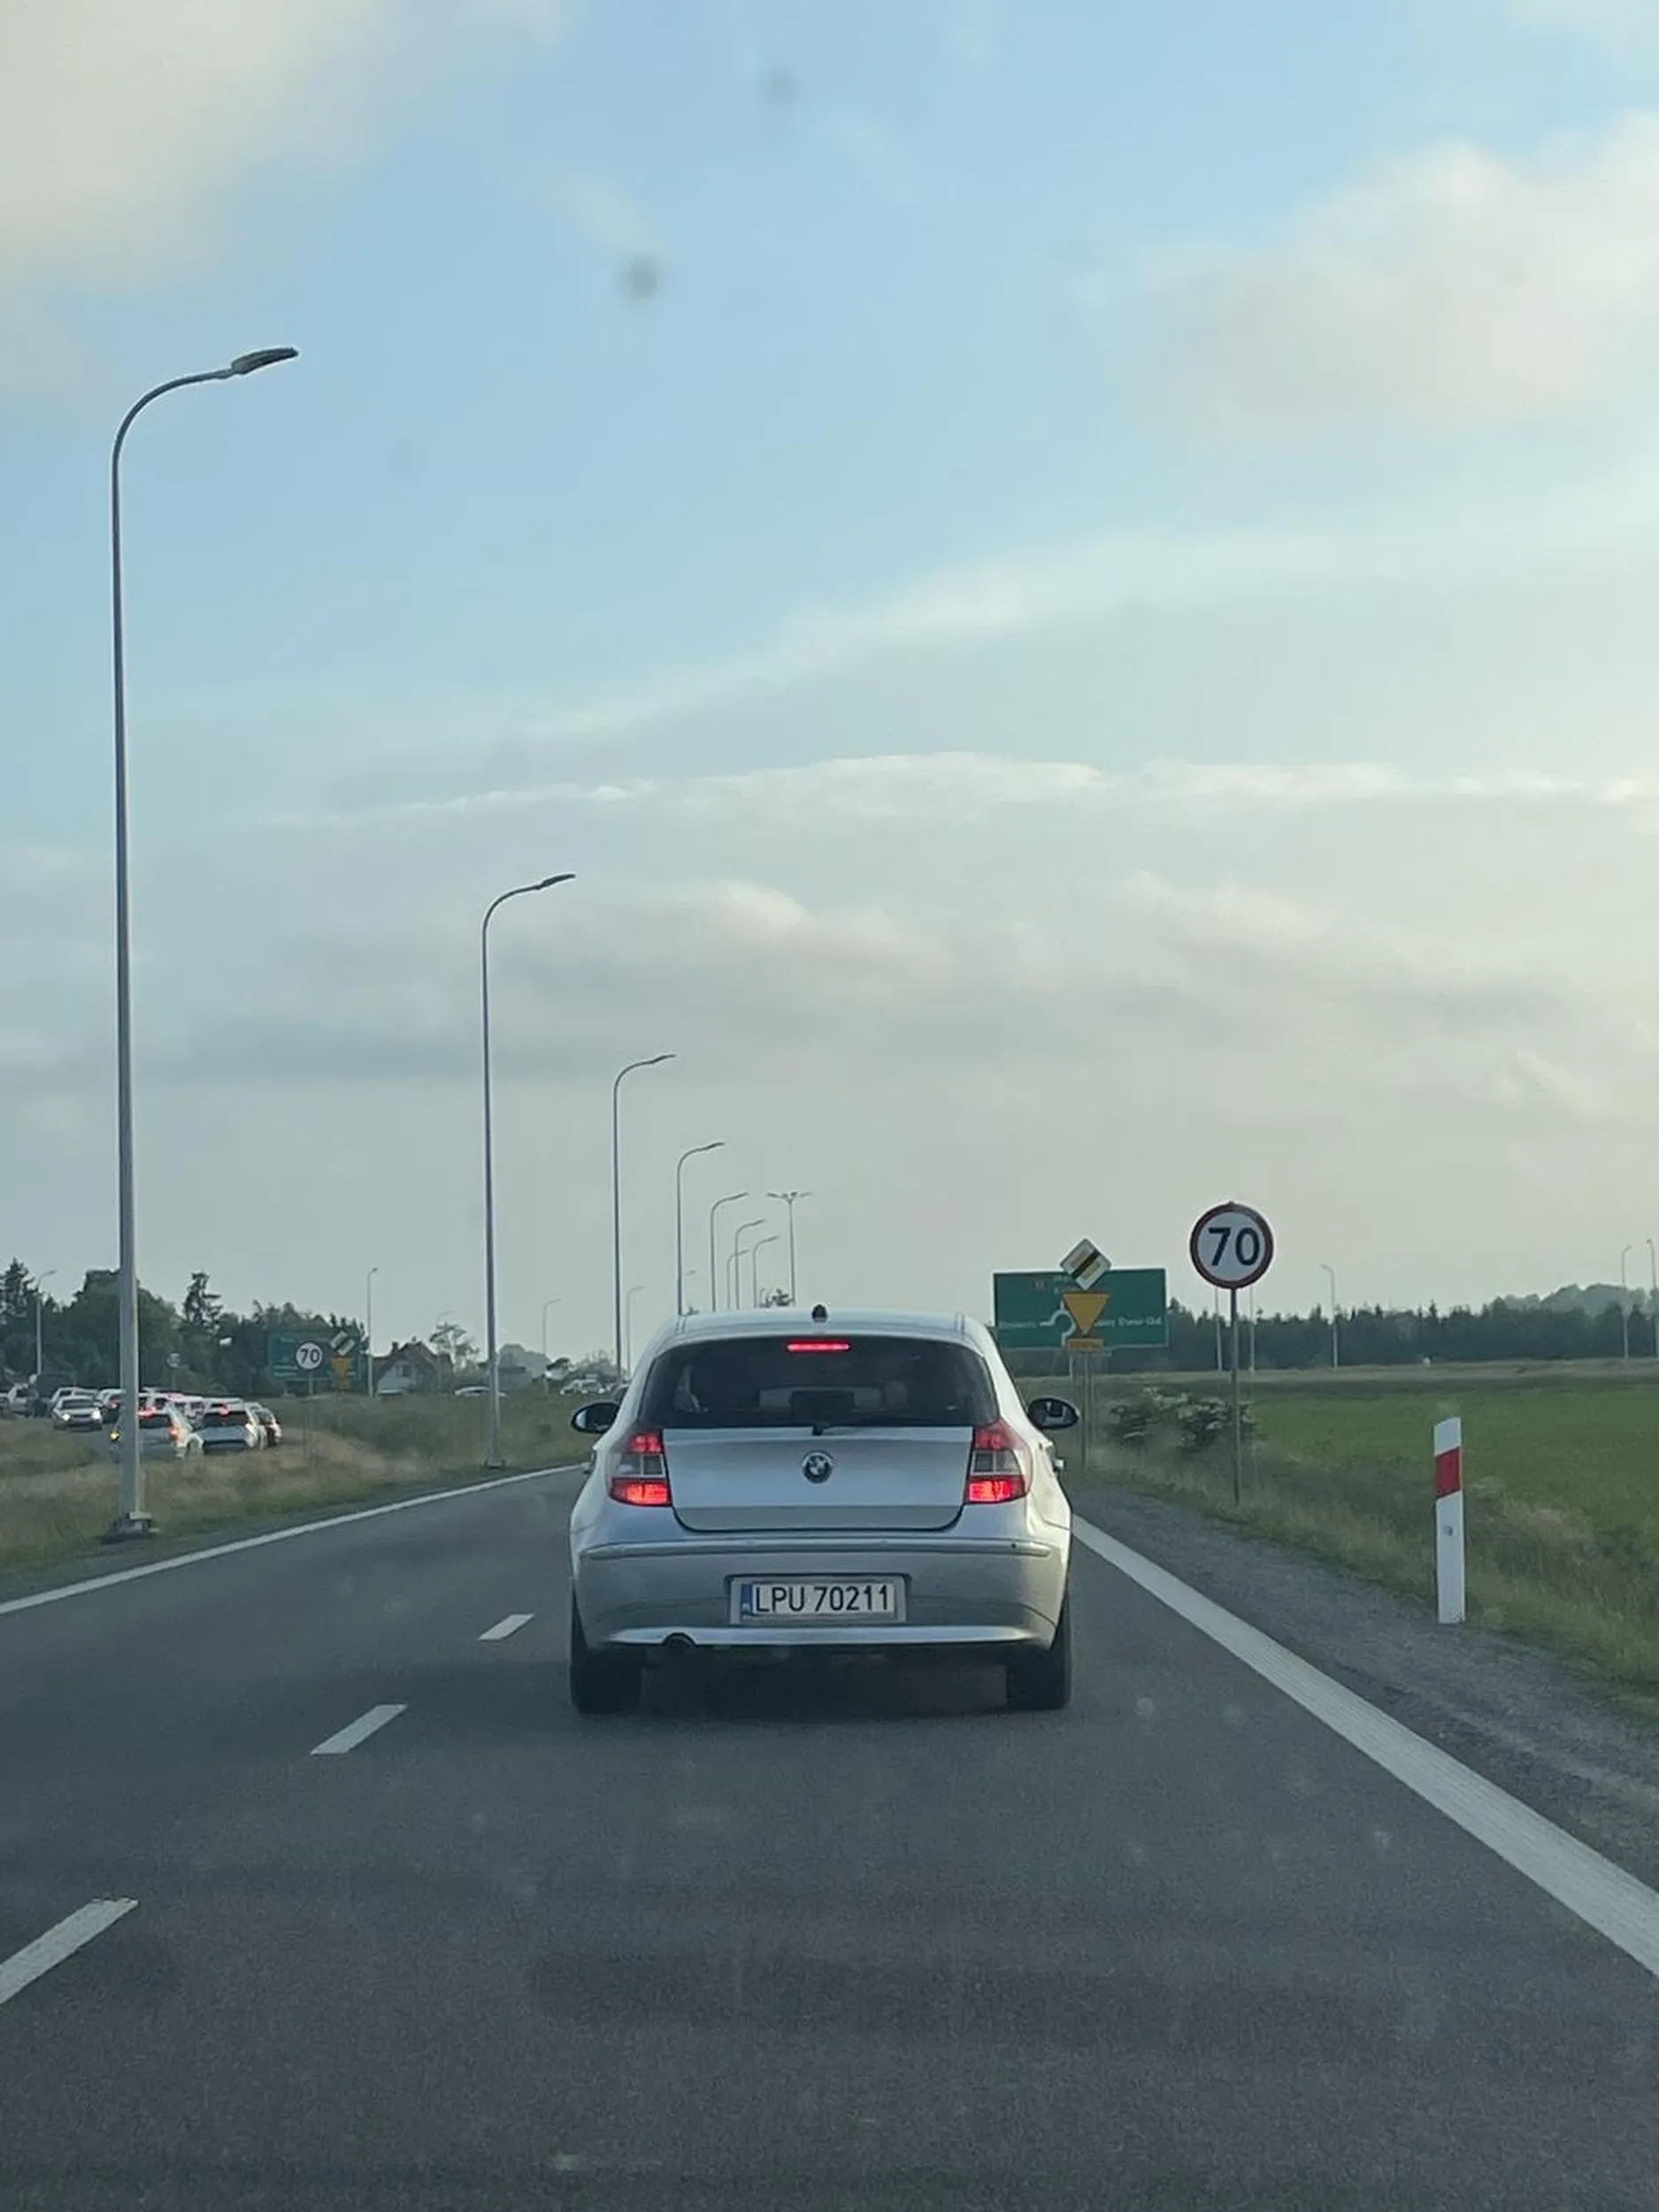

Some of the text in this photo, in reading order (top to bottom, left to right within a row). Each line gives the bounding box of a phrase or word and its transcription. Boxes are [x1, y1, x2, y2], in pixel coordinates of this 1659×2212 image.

[1208, 1226, 1260, 1266] 70
[301, 1348, 320, 1364] 70
[756, 1585, 887, 1612] LPU 70211
